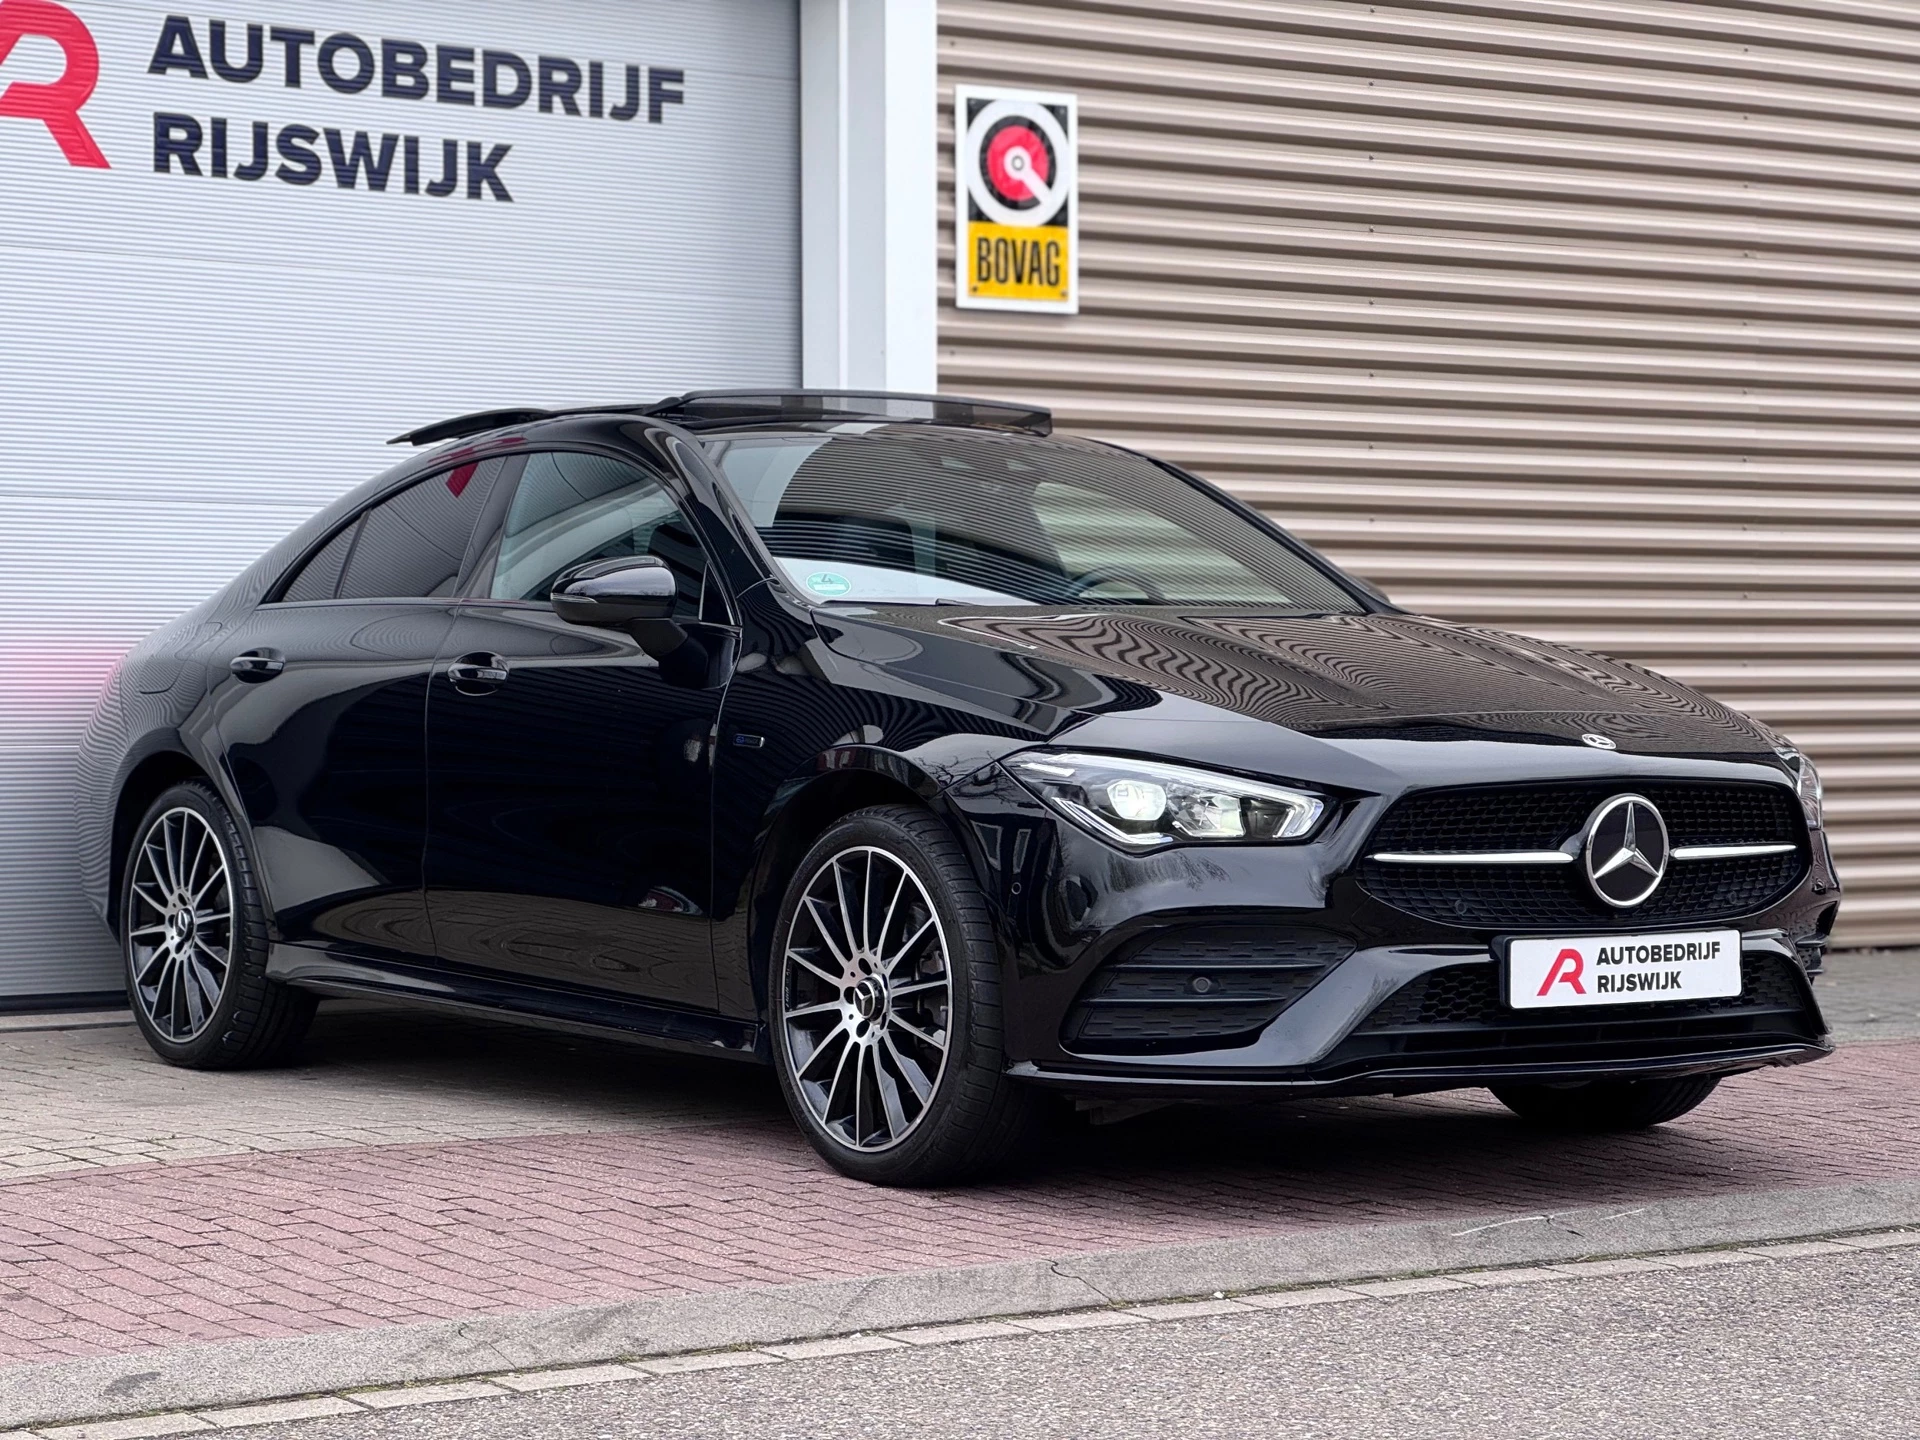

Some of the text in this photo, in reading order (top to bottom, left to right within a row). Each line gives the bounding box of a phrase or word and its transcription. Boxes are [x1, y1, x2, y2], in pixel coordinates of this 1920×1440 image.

[147, 15, 685, 124] AUTOBEDRIJF
[153, 112, 514, 202] RIJSWIJK
[977, 237, 1060, 287] BOVAG
[1596, 941, 1721, 966] AUTOBEDRIJF
[1597, 971, 1682, 994] RIJSWIJK
